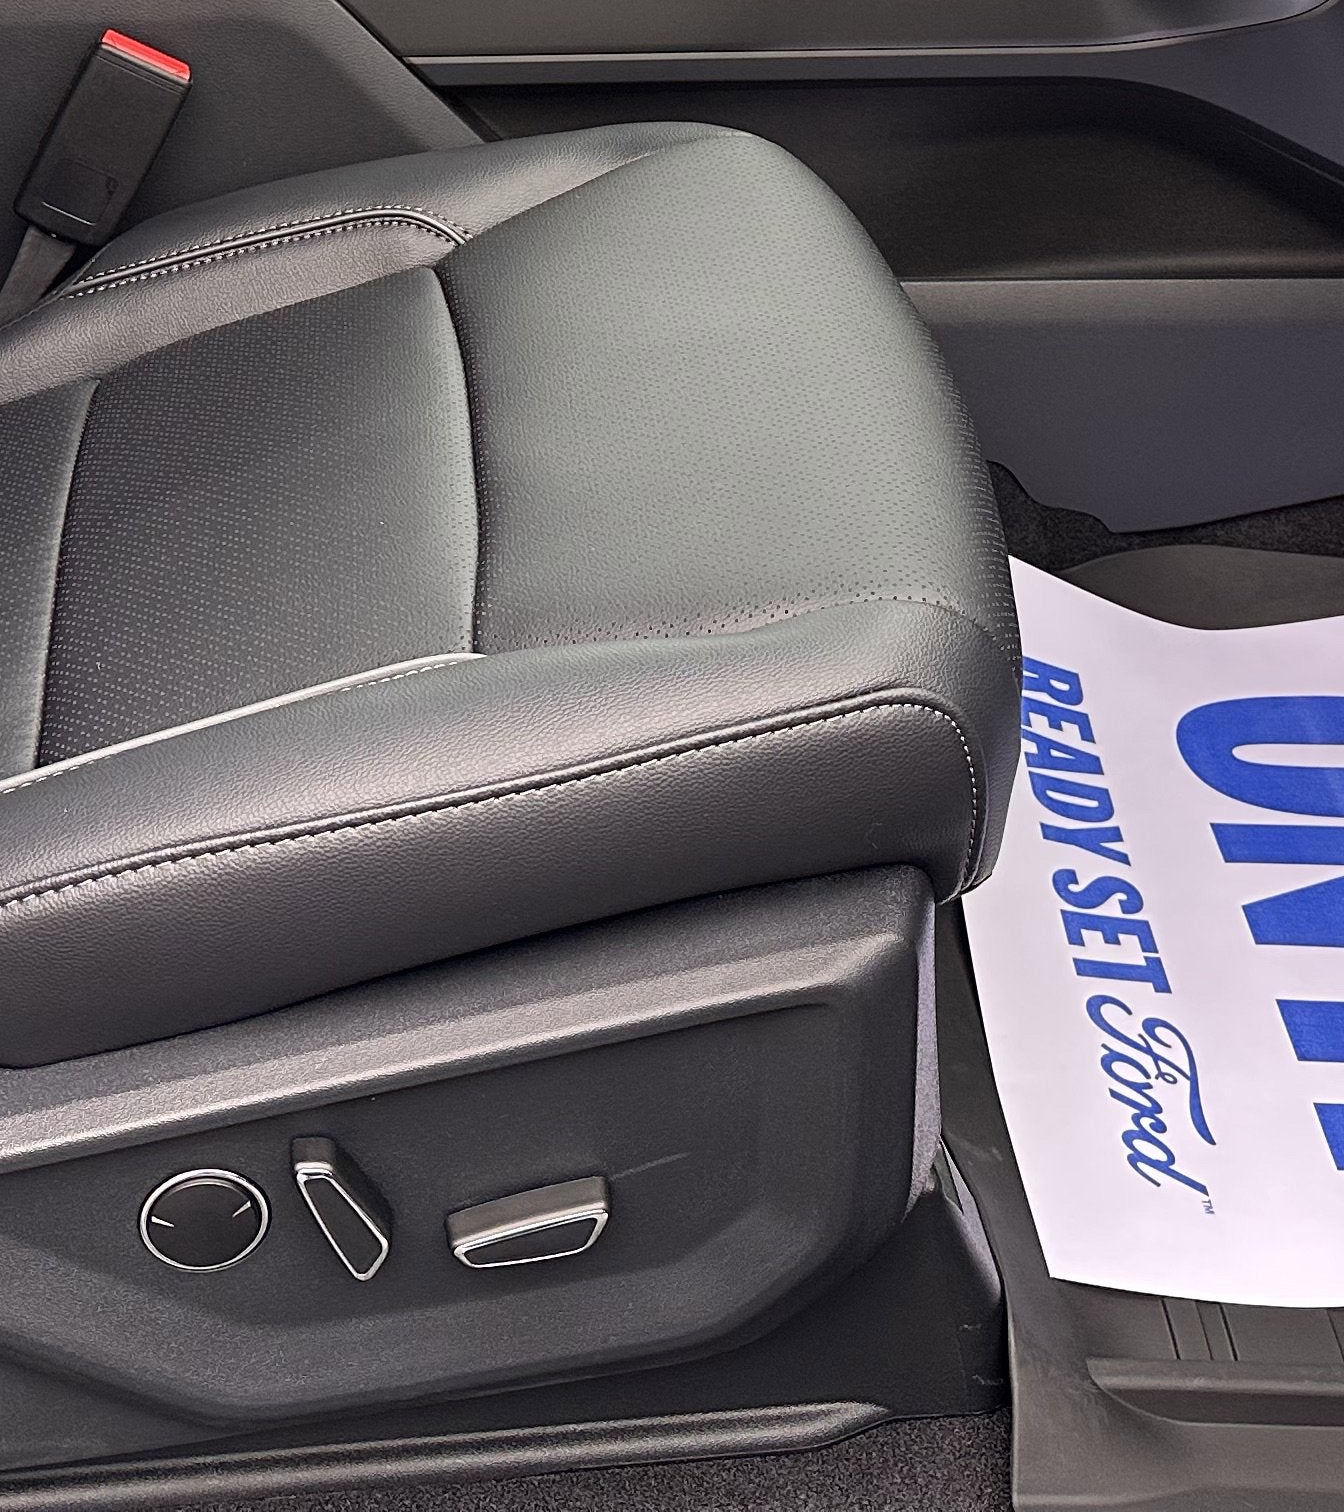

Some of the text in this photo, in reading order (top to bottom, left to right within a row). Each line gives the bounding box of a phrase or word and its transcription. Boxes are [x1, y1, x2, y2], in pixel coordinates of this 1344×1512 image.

[1021, 655, 1132, 867] READY
[1052, 867, 1173, 995] SET
[1085, 994, 1217, 1197] Ford
